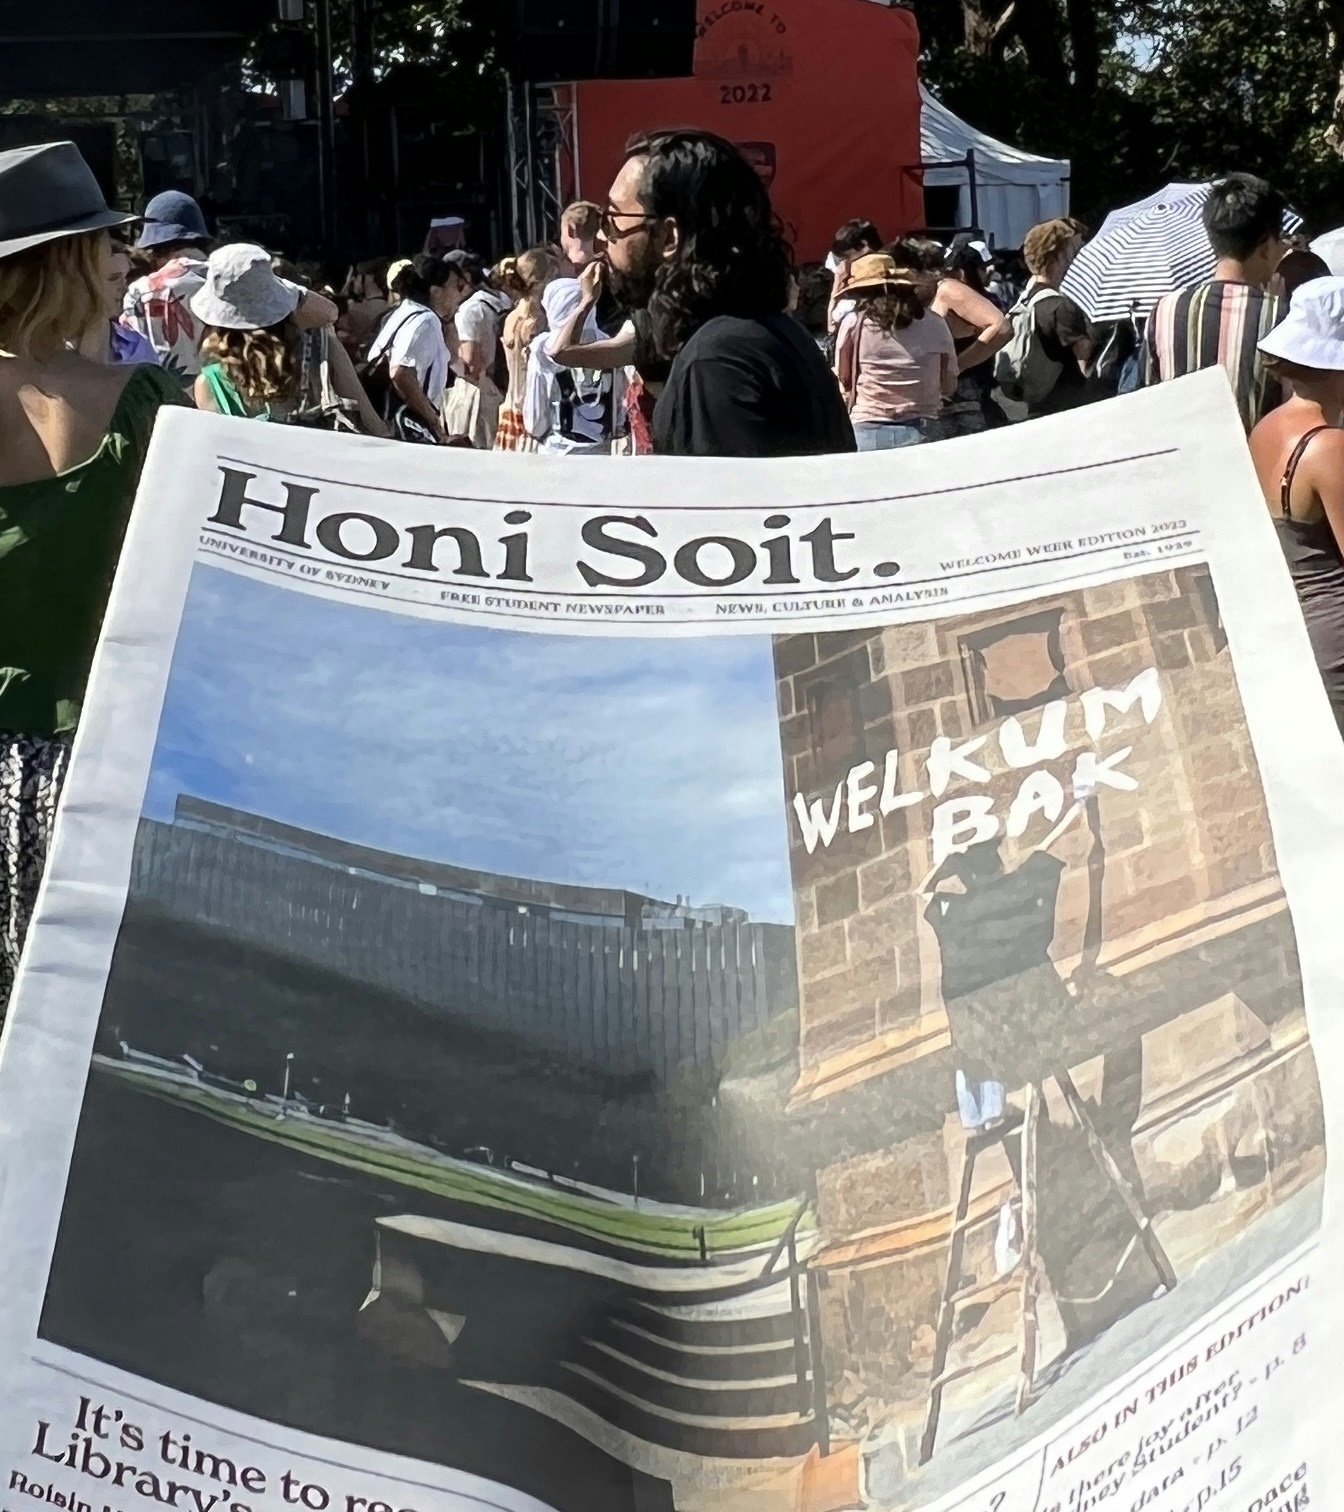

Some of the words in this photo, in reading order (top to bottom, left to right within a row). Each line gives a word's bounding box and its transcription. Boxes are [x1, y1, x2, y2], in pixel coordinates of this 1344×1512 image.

[769, 12, 787, 34] TO
[720, 83, 773, 104] 2022
[207, 465, 533, 582] Honi
[576, 513, 901, 588] Soit.
[939, 547, 1021, 572] WELCOME
[1025, 539, 1074, 557] WEEK
[1077, 526, 1147, 547] EDITION
[199, 535, 296, 570] UNIVERSITY
[299, 564, 322, 577] OF
[325, 569, 391, 591] SYDNEY
[439, 590, 481, 606] FREE
[485, 595, 561, 613] STUDENT
[565, 602, 666, 616] NEWSPAPER
[772, 597, 847, 613] CULTURE
[868, 586, 949, 605] ANALYSIS
[793, 667, 1163, 854] WELKUM
[930, 745, 1139, 866] BAK
[1050, 1423, 1108, 1479] ALSO
[1114, 1398, 1139, 1429] IN
[1145, 1354, 1199, 1405] THIS
[74, 1395, 145, 1452] It's
[158, 1429, 267, 1494] time
[280, 1469, 331, 1511] to
[344, 1494, 419, 1512] re
